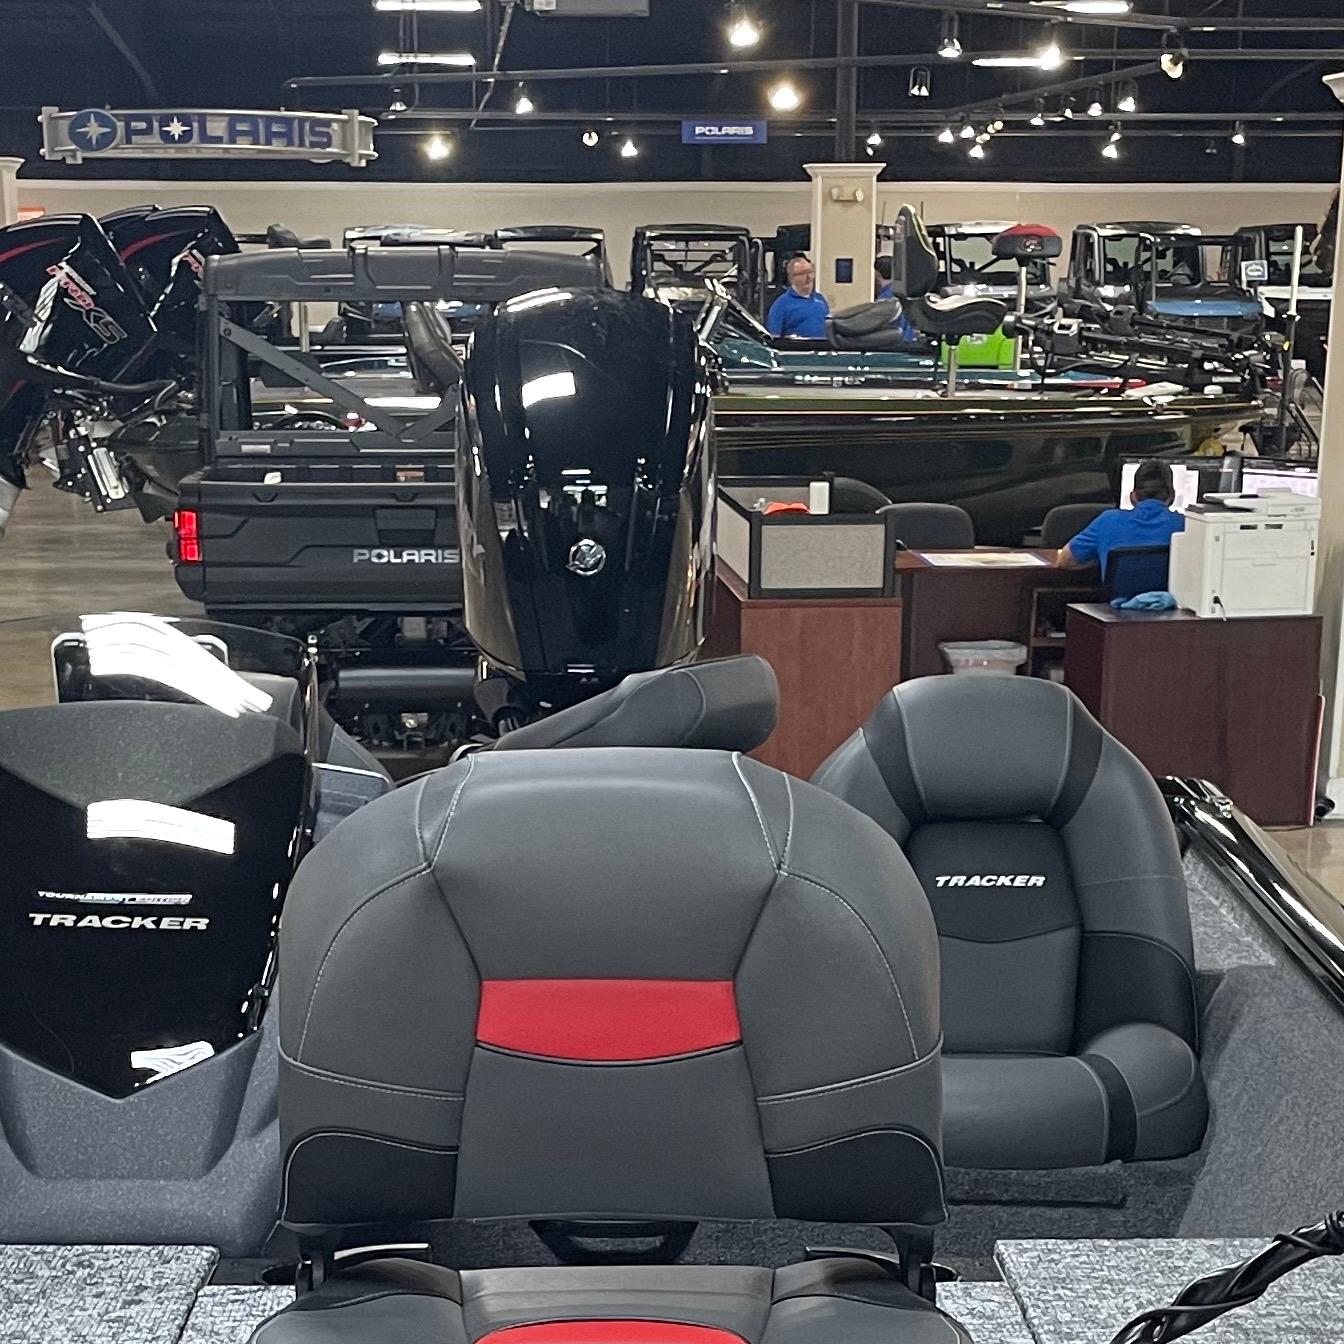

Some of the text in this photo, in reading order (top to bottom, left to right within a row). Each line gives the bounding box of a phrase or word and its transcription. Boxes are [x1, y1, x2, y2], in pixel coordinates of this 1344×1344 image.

[123, 114, 334, 150] POLARIS
[694, 126, 754, 136] POLARIS
[352, 549, 461, 564] POLARIS
[935, 874, 1046, 888] TRACKER
[28, 912, 210, 931] TRACKER
